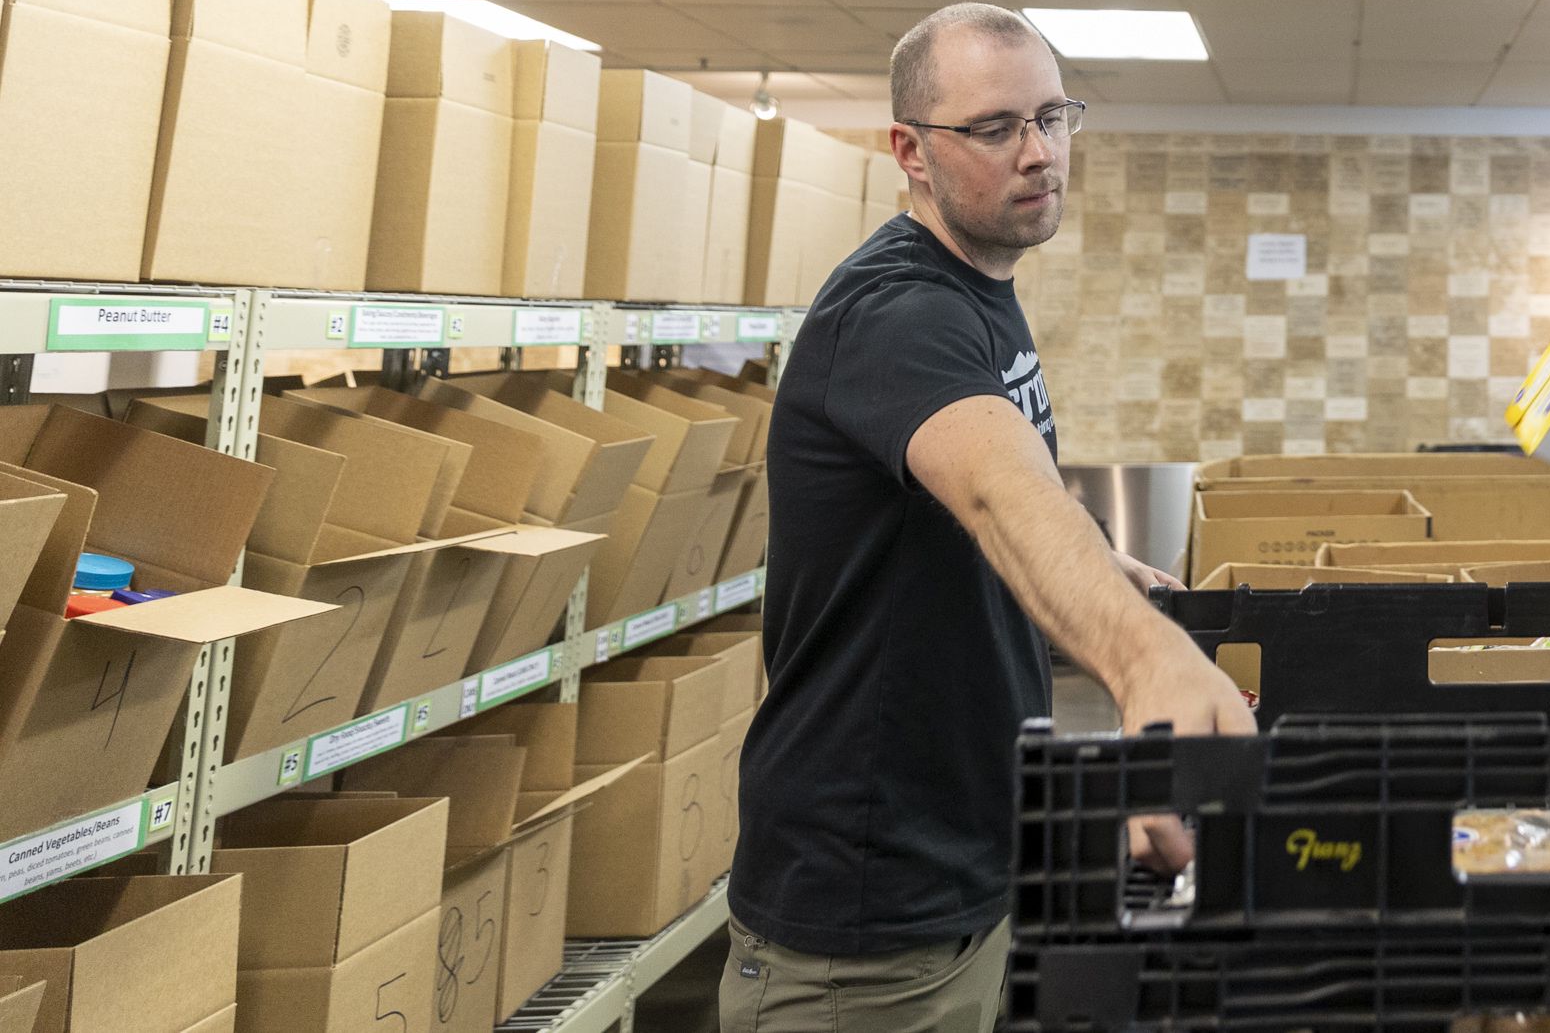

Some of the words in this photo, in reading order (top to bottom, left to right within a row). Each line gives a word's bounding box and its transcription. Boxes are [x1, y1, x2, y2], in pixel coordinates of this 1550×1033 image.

[97, 308, 138, 322] Peanut
[139, 309, 172, 323] Butter
[213, 316, 229, 333] #4
[330, 317, 343, 333] #2
[452, 318, 462, 333] #2
[281, 584, 365, 725] 2
[90, 649, 138, 752] 4
[416, 704, 429, 723] #5
[283, 752, 299, 774] #5
[153, 801, 173, 824] #7
[8, 841, 44, 864] Canned
[45, 816, 121, 850] Vegetables/Beans
[27, 859, 45, 874] diced
[45, 849, 75, 866] tomatoes,
[76, 842, 93, 855] green
[113, 826, 135, 840] canned
[375, 971, 408, 1033] 5
